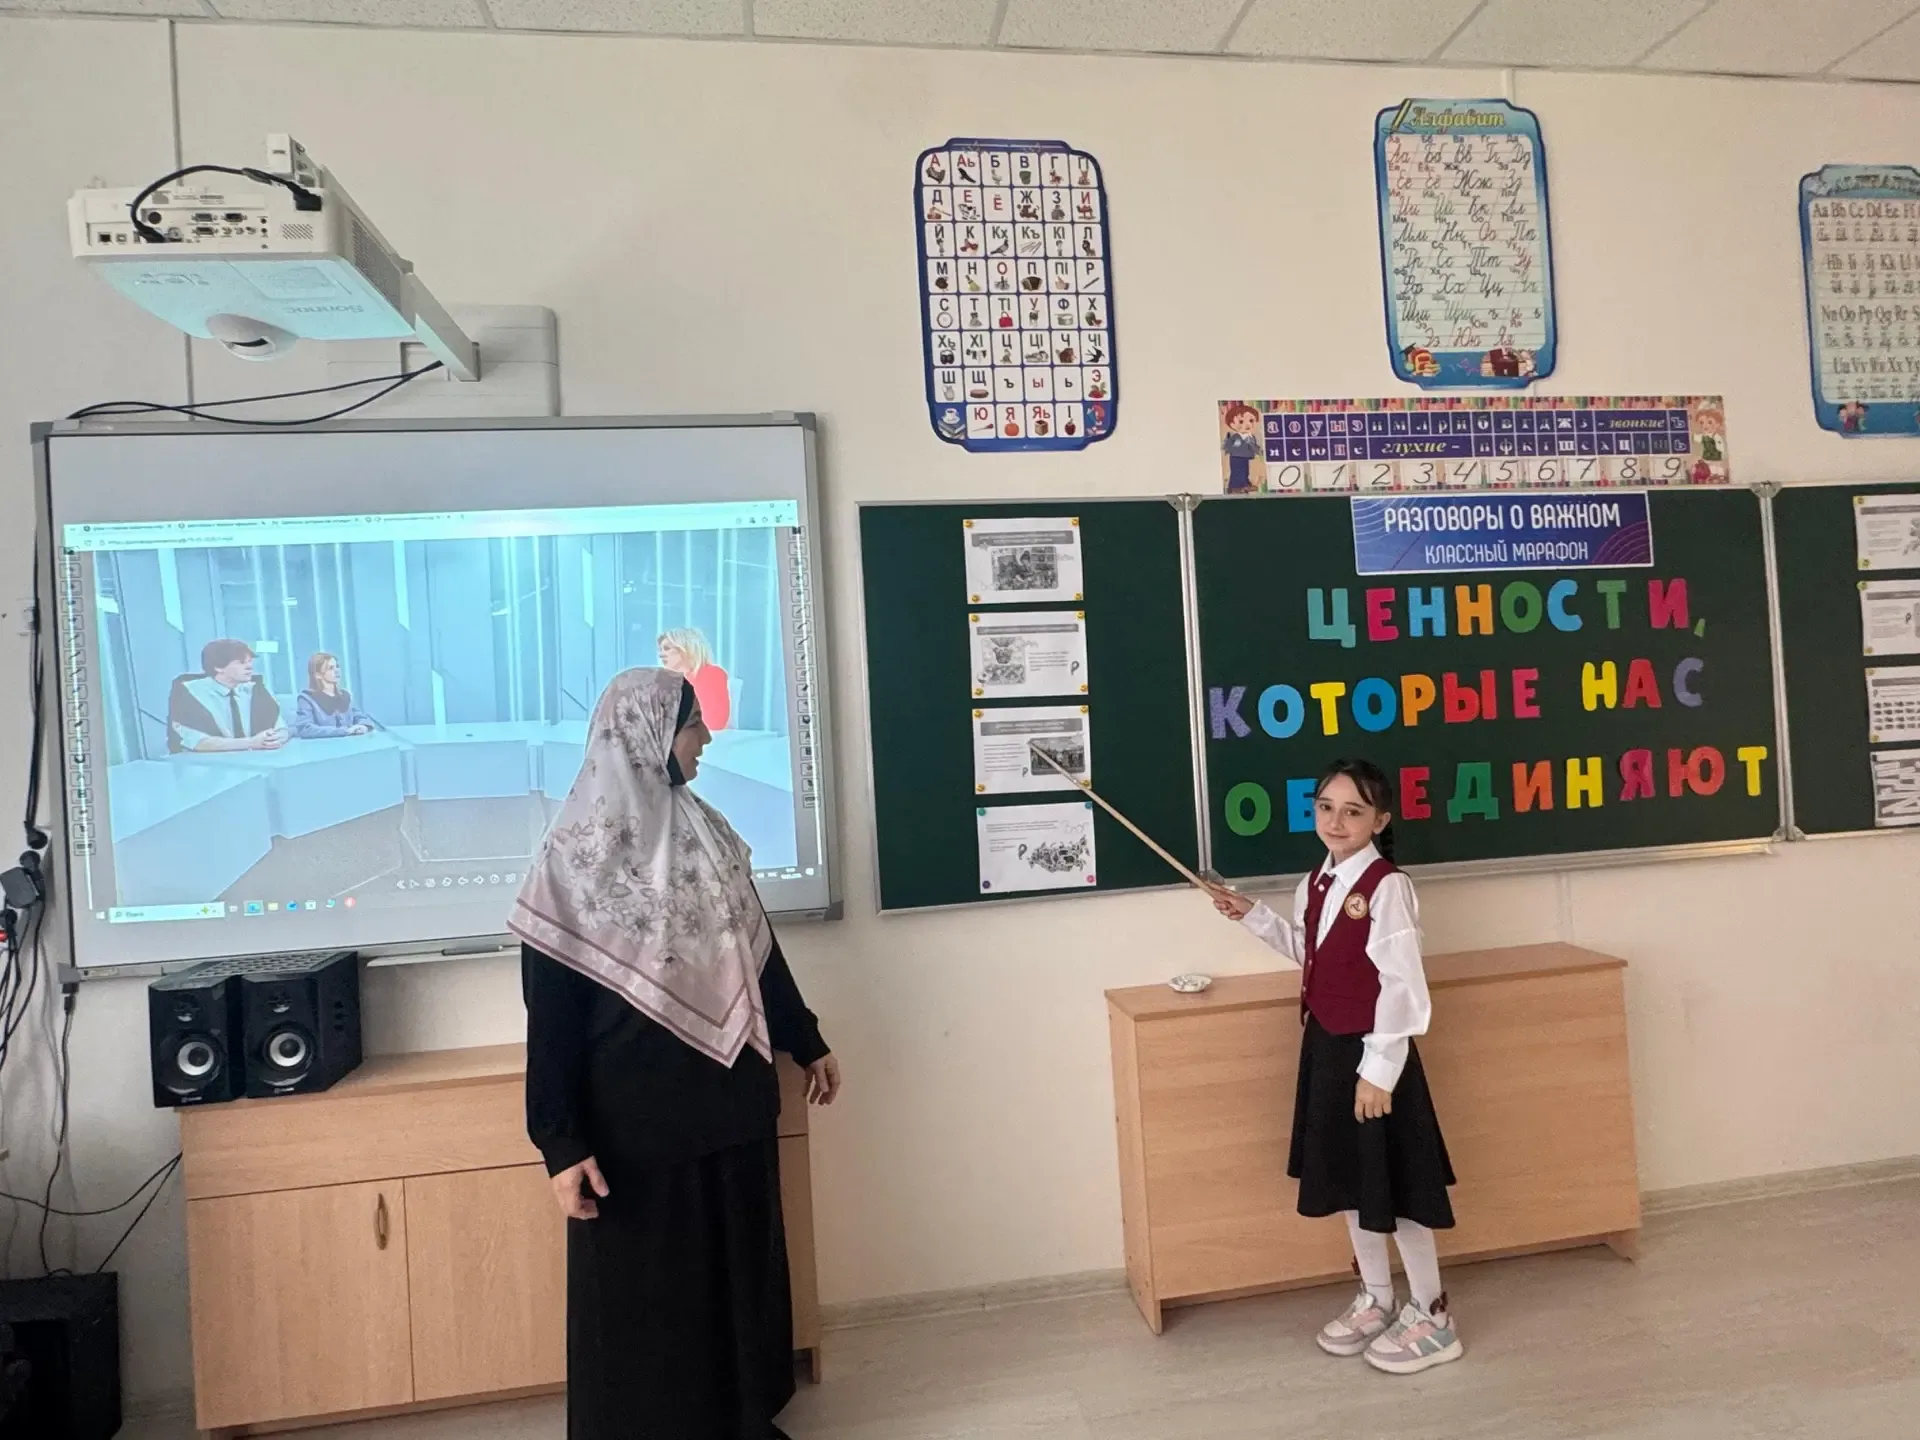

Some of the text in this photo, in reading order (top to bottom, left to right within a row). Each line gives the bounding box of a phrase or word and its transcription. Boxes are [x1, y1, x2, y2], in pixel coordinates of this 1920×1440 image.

[931, 153, 941, 167] А
[990, 154, 1000, 168] Б
[1020, 155, 1029, 169] В
[1051, 156, 1058, 169] Г
[932, 189, 1091, 211] Д Е Ё Ж З И
[934, 223, 944, 239] Й
[966, 225, 974, 239] К
[992, 226, 1008, 239] Кх
[1022, 226, 1040, 239] Къ
[1083, 226, 1093, 239] Л
[936, 262, 948, 275] М
[968, 262, 977, 275] Н
[997, 262, 1008, 275] О
[1028, 262, 1037, 275] П
[1086, 262, 1095, 275] Р
[940, 298, 949, 311] С
[970, 298, 979, 311] Т
[1030, 298, 1038, 311] У
[1058, 298, 1070, 310] Ф
[1088, 298, 1097, 310] Х
[938, 334, 956, 349] Хь
[1001, 334, 1012, 349] Ц
[1061, 334, 1070, 346] Ч
[942, 371, 955, 384] Ш
[972, 370, 986, 386] Щ
[1092, 369, 1102, 383] Э
[974, 407, 988, 420] Ю
[1005, 407, 1015, 420] Я
[1033, 406, 1051, 420] Яь
[1381, 440, 1447, 456] глухие
[1278, 457, 1681, 487] 0 1 2 3 4 5 6 7 8 9
[1384, 503, 1621, 533] РАЗГОВОРЫ О ВАЖНОМ
[1425, 540, 1589, 564] КЛАССНЫЙ МАРАФОН
[1307, 578, 1706, 648] ЦЕННОСТИ,
[1208, 657, 1705, 739] КОТОРЫЕ НАС
[1224, 745, 1768, 836] ОБЕДИНЯЮТ
